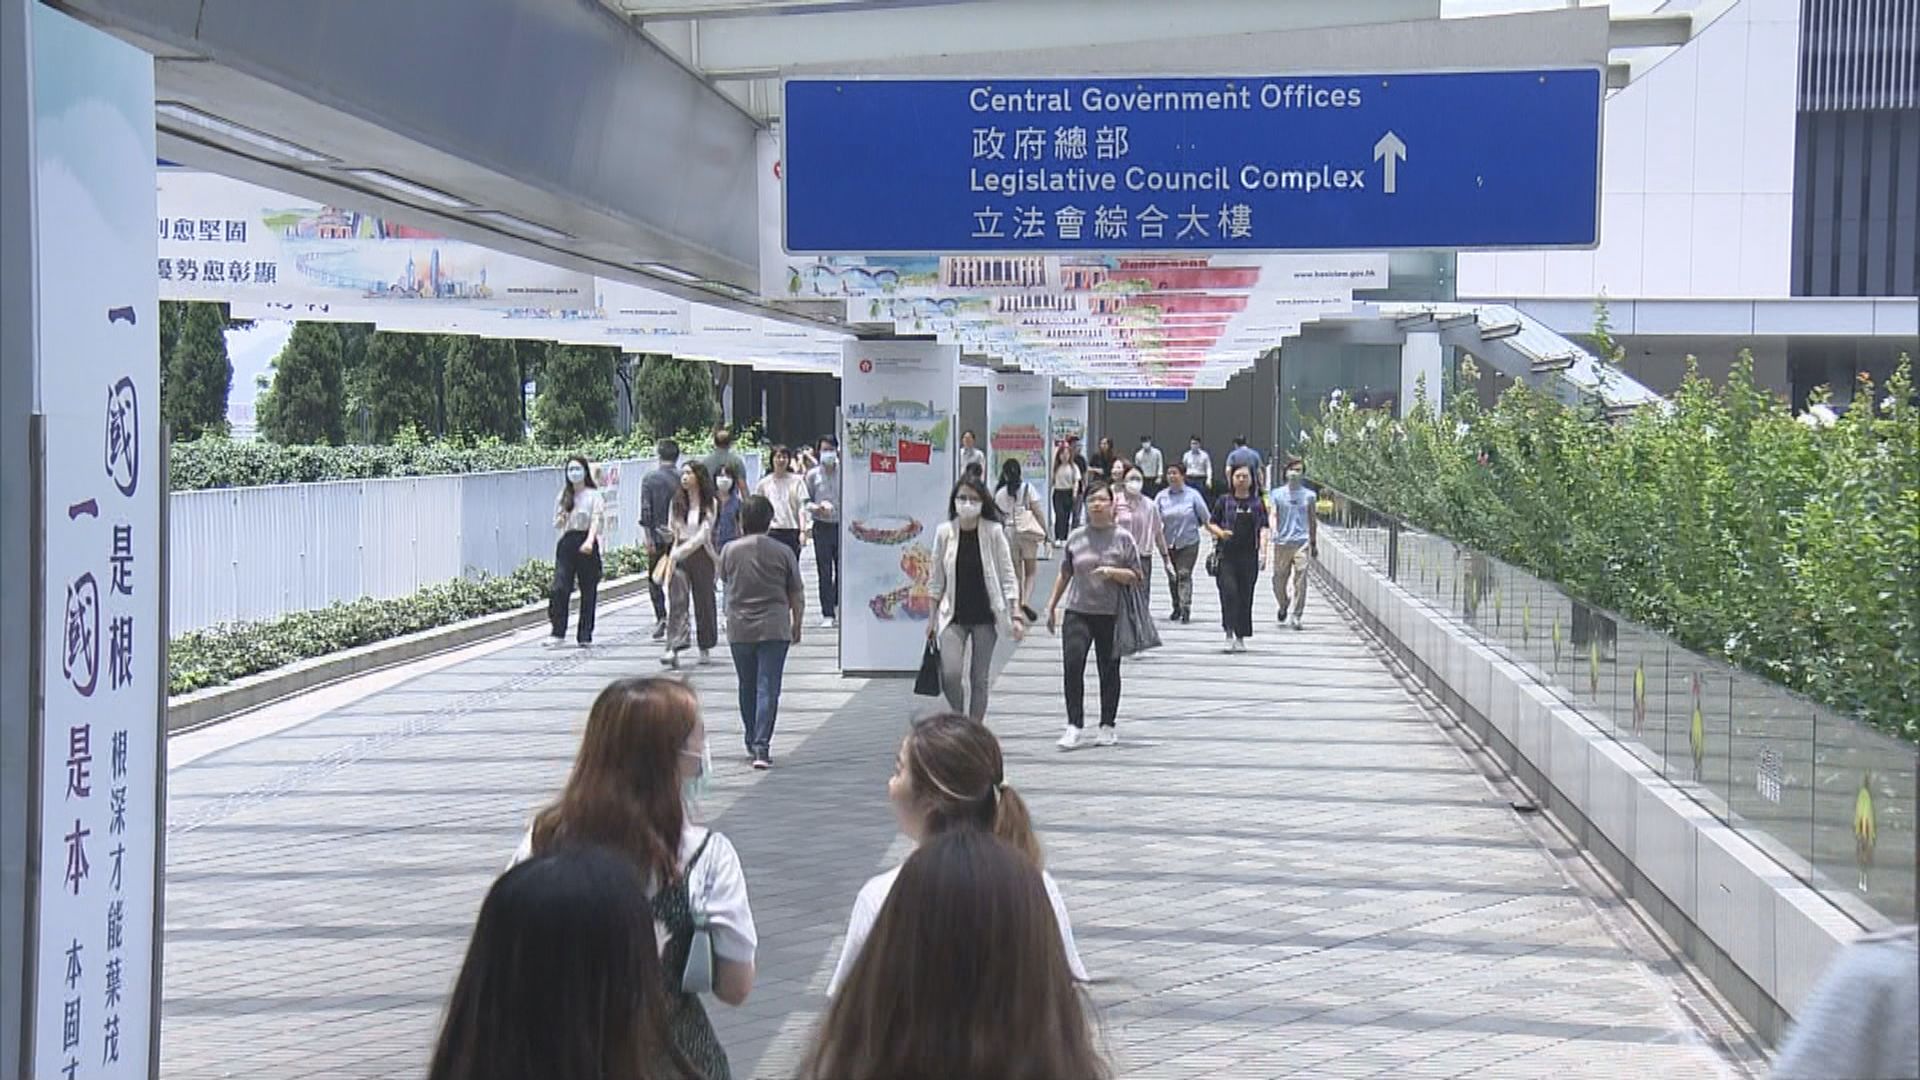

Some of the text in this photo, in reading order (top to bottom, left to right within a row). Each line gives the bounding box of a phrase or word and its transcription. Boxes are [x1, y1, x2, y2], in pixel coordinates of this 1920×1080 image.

[969, 84, 1361, 112] Central Government Offices
[972, 126, 1129, 160] 政府總部
[970, 164, 1365, 197] Legislative Council Complex
[971, 203, 1253, 240] 立法會綜合大樓
[62, 498, 100, 895] 一國是本
[103, 305, 139, 1067] 一國是根 根深才能葉茂
